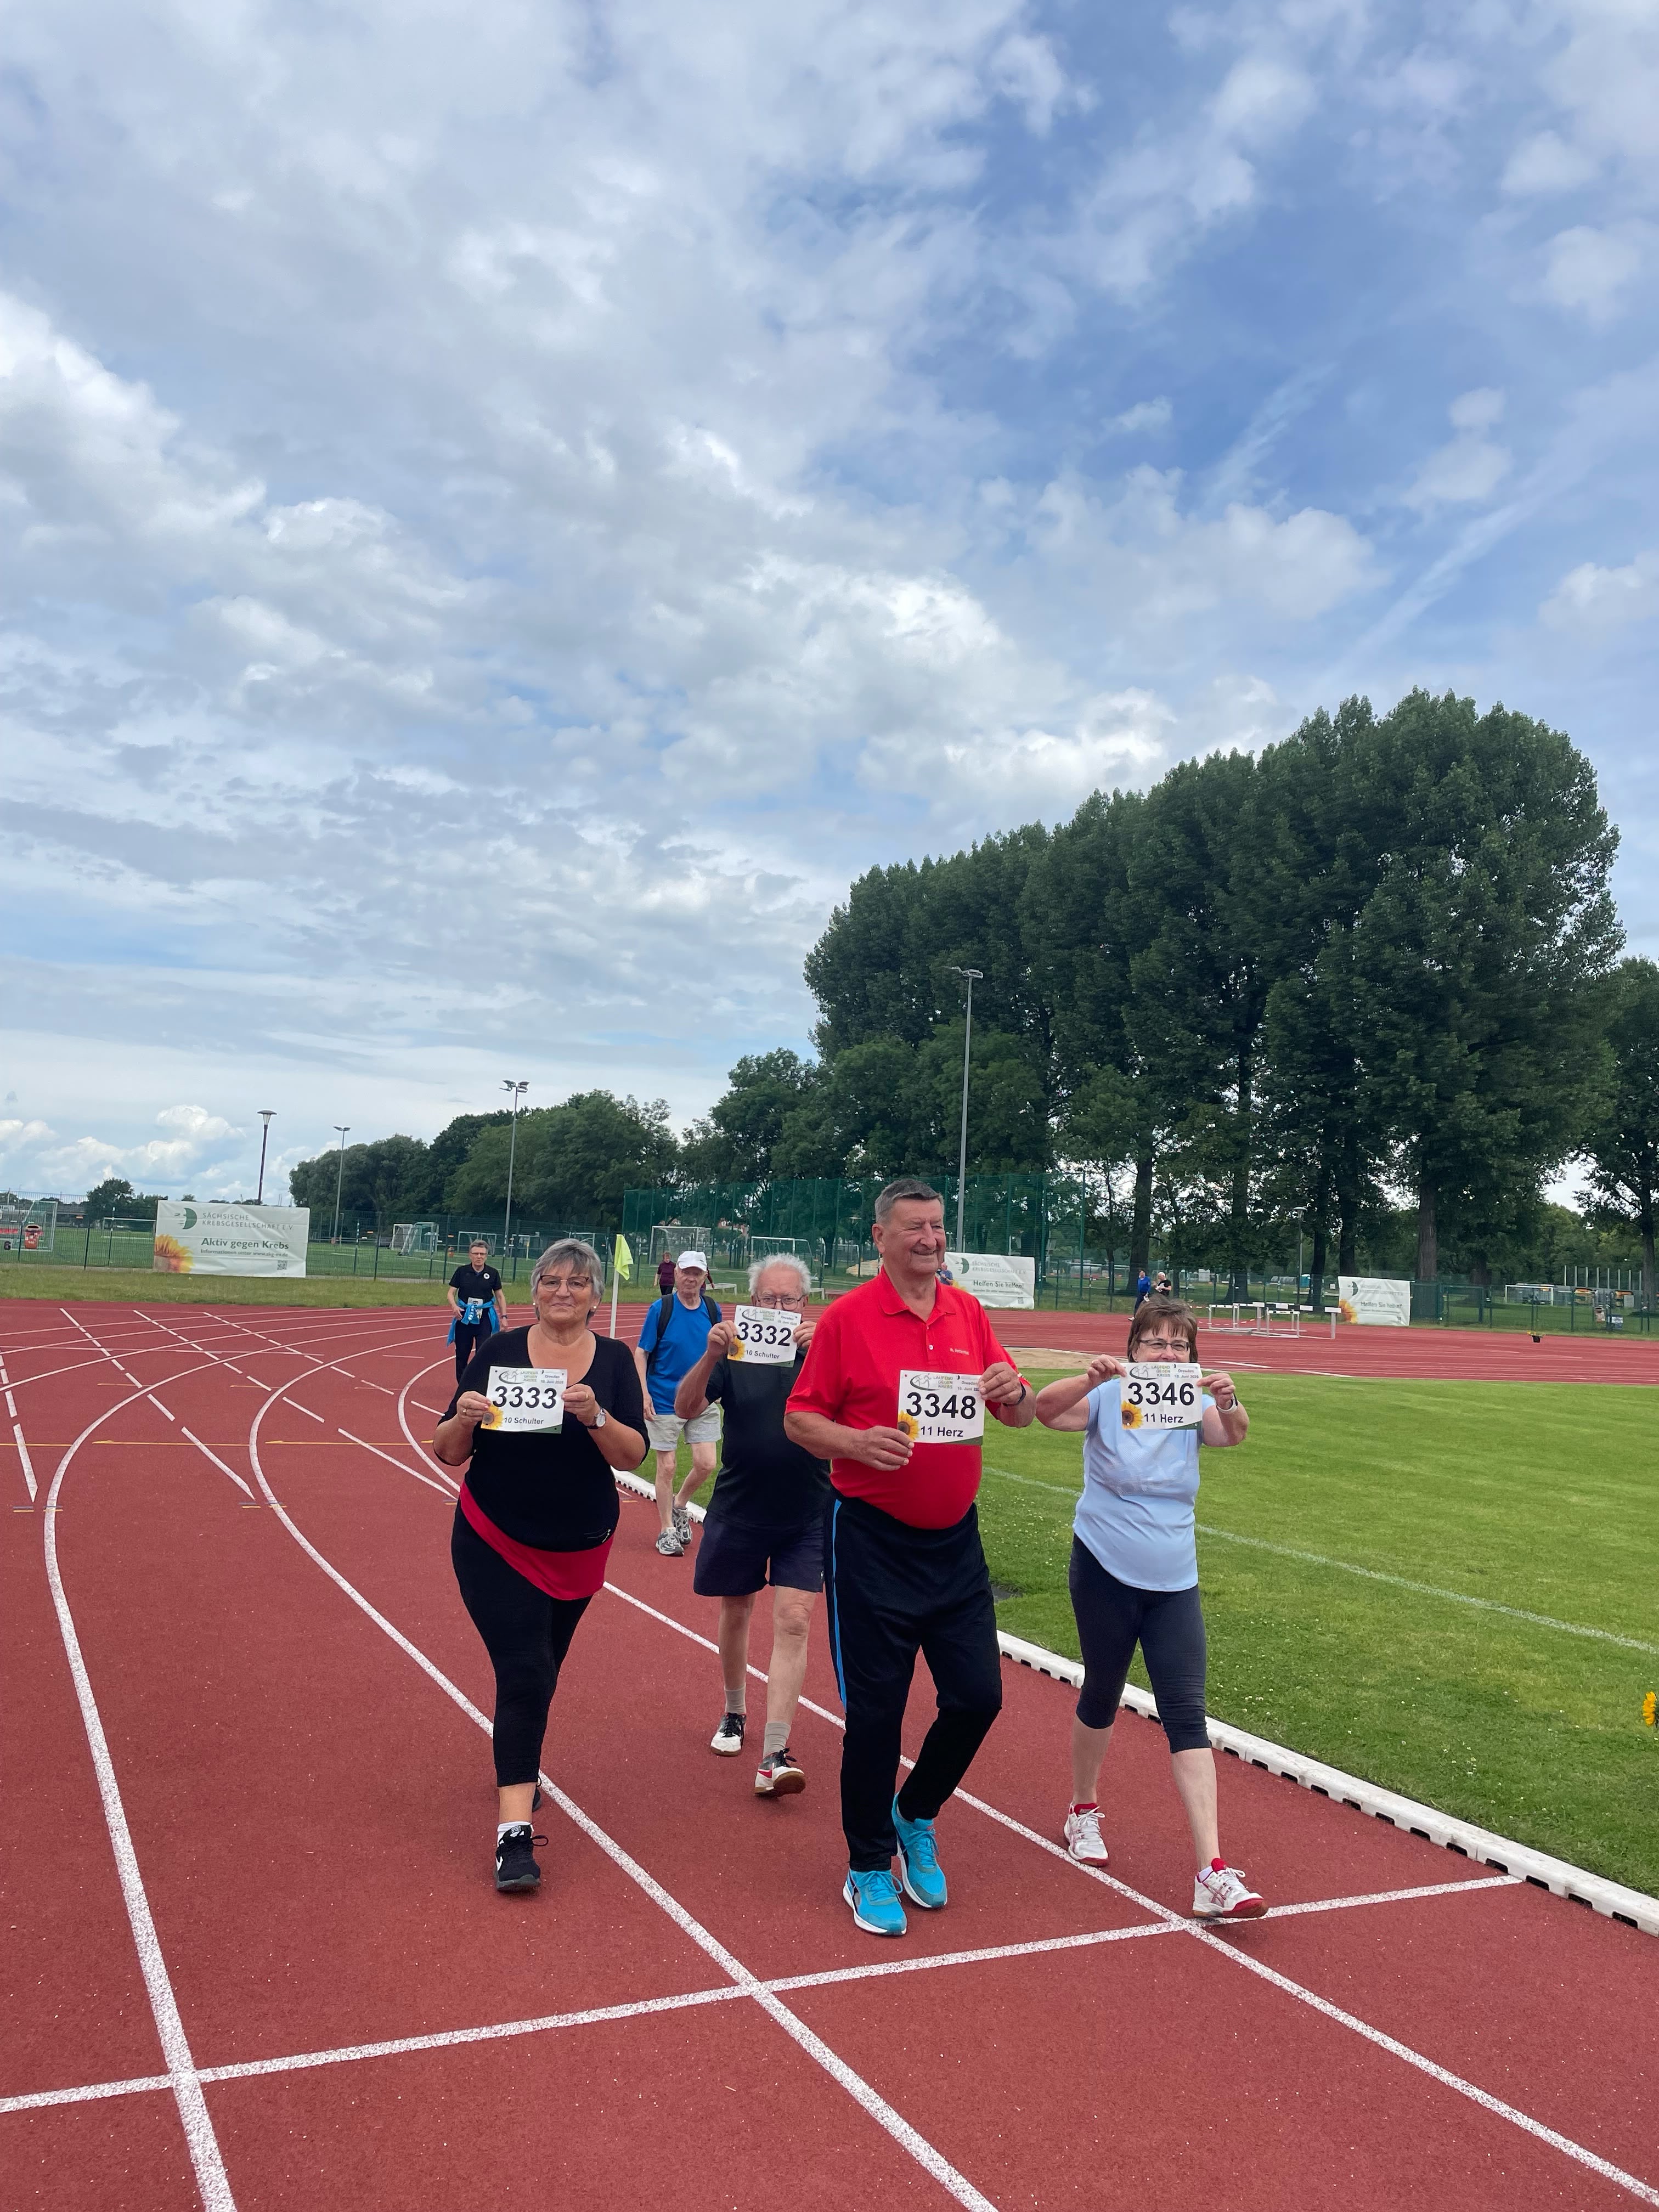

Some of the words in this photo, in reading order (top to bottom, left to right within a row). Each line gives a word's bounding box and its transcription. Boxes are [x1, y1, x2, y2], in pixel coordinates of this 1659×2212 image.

[202, 1220, 280, 1229] KREBSGESELLSCHAFT
[201, 1238, 228, 1246] Aktiv
[262, 1240, 289, 1250] Krebs
[736, 1322, 792, 1347] 3332
[754, 1351, 780, 1359] Schulter
[493, 1386, 557, 1409] 3333
[1128, 1382, 1194, 1406] 3346
[906, 1391, 976, 1420] 3348
[1144, 1413, 1155, 1422] 11
[1160, 1414, 1183, 1423] Herz
[921, 1426, 932, 1436] 11
[937, 1427, 963, 1437] Herz
